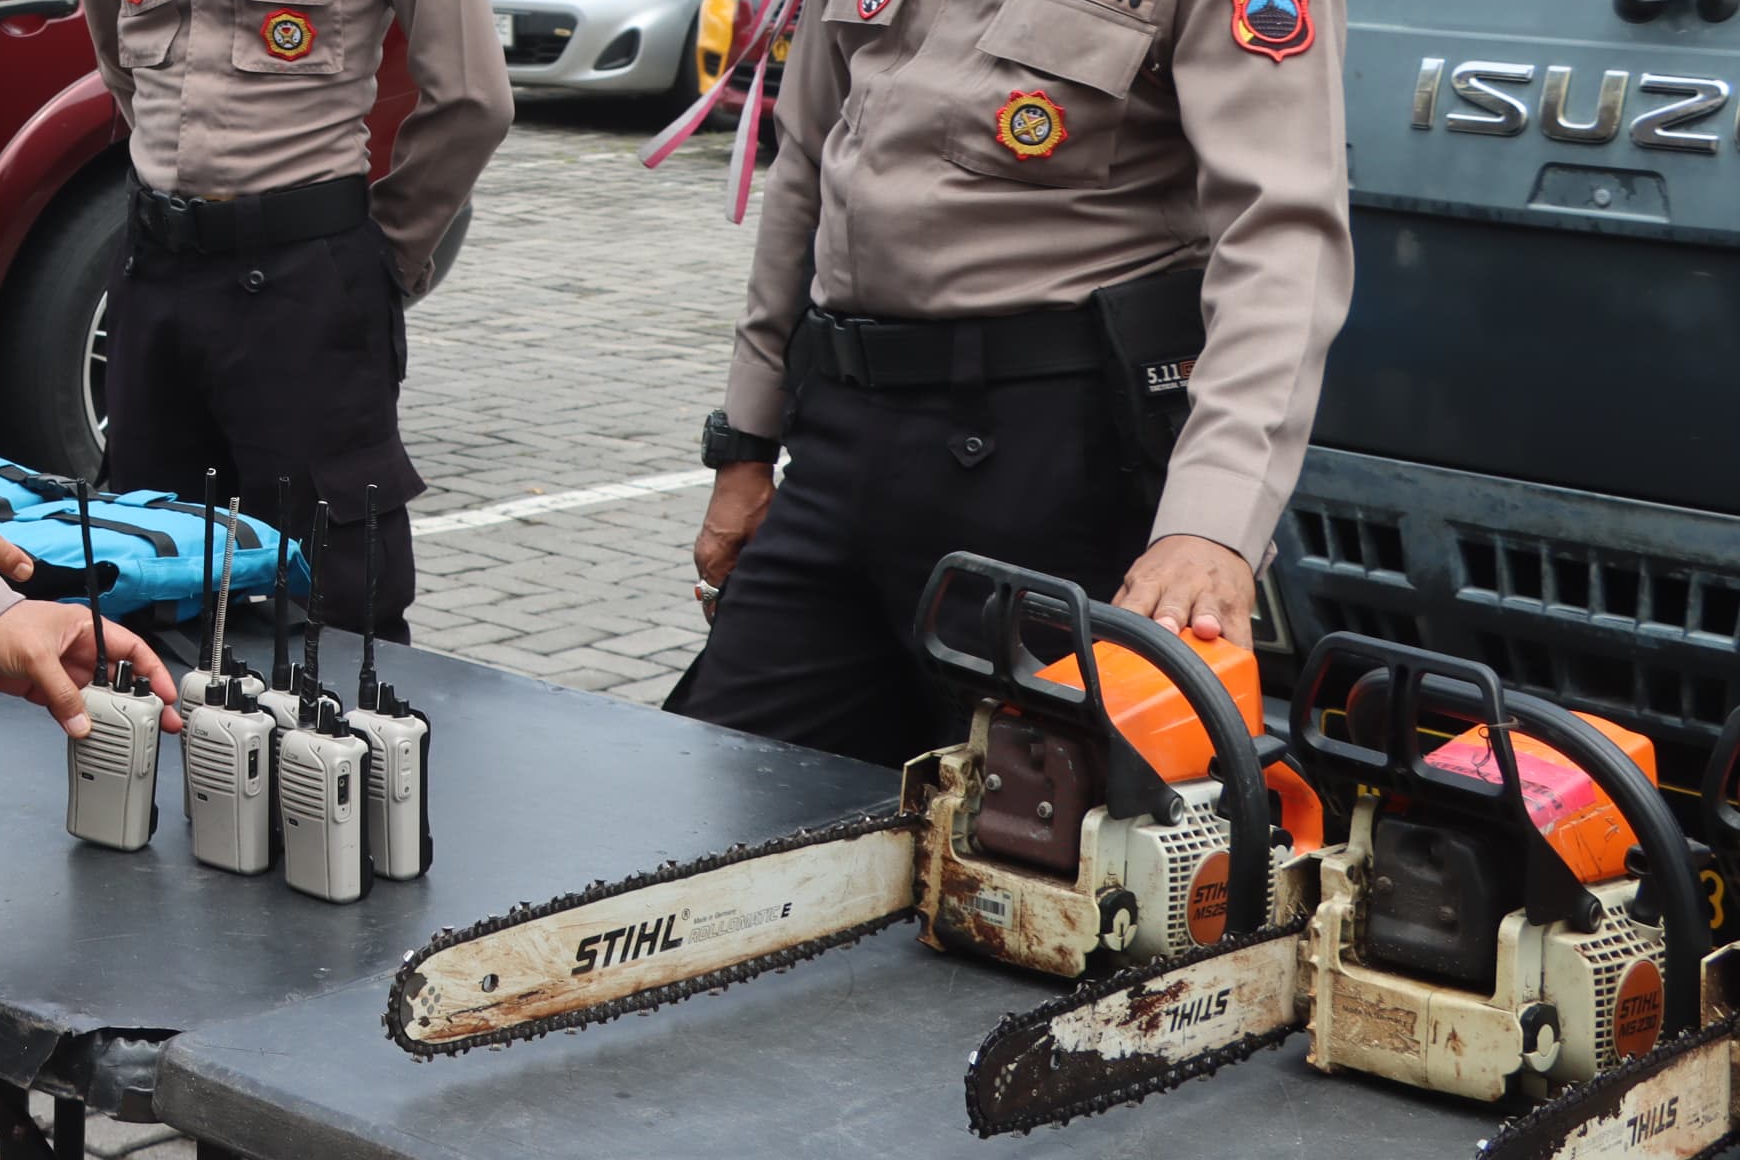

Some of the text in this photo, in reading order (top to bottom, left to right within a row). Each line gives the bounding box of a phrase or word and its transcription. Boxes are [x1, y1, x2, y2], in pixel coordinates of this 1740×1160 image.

[1411, 57, 1740, 156] ISUZ
[1147, 363, 1181, 385] 5.11
[1193, 881, 1228, 905] STIH
[571, 913, 684, 976] STIHL
[1166, 988, 1231, 1032] STIHL
[1619, 989, 1659, 1019] STIHL
[1626, 1095, 1679, 1147] STIHL
